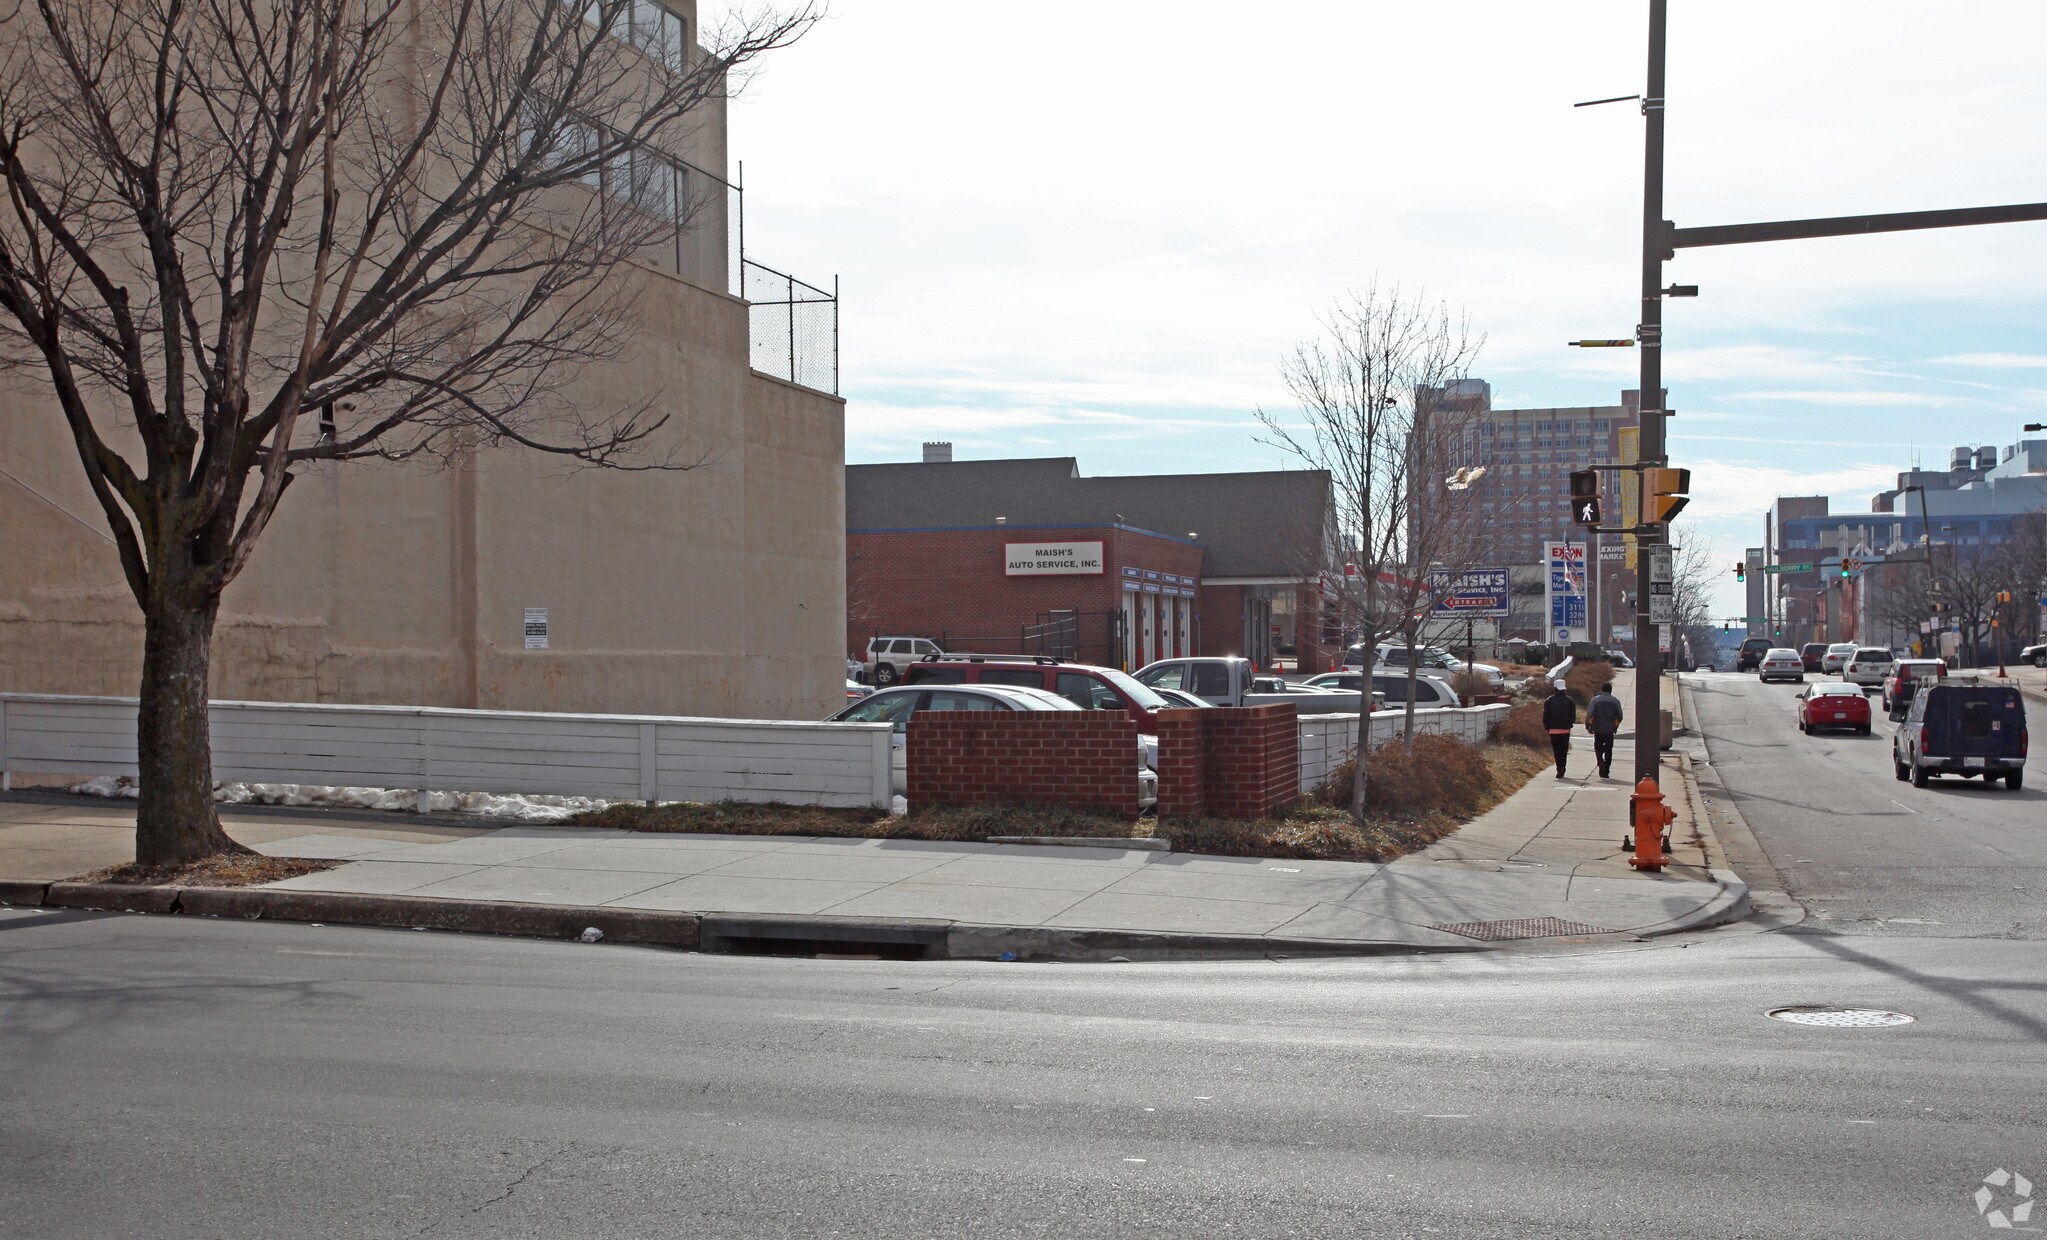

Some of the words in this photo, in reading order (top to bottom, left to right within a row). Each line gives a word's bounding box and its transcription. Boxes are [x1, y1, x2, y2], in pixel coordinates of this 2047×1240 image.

[1552, 547, 1583, 559] EXN
[1008, 561, 1034, 569] AUTO
[1036, 560, 1079, 569] SERVICE,
[1766, 565, 1800, 573] MULBERRY
[1433, 574, 1505, 587] MAISH'S
[1654, 572, 1669, 580] PARKING
[1651, 584, 1657, 593] NO
